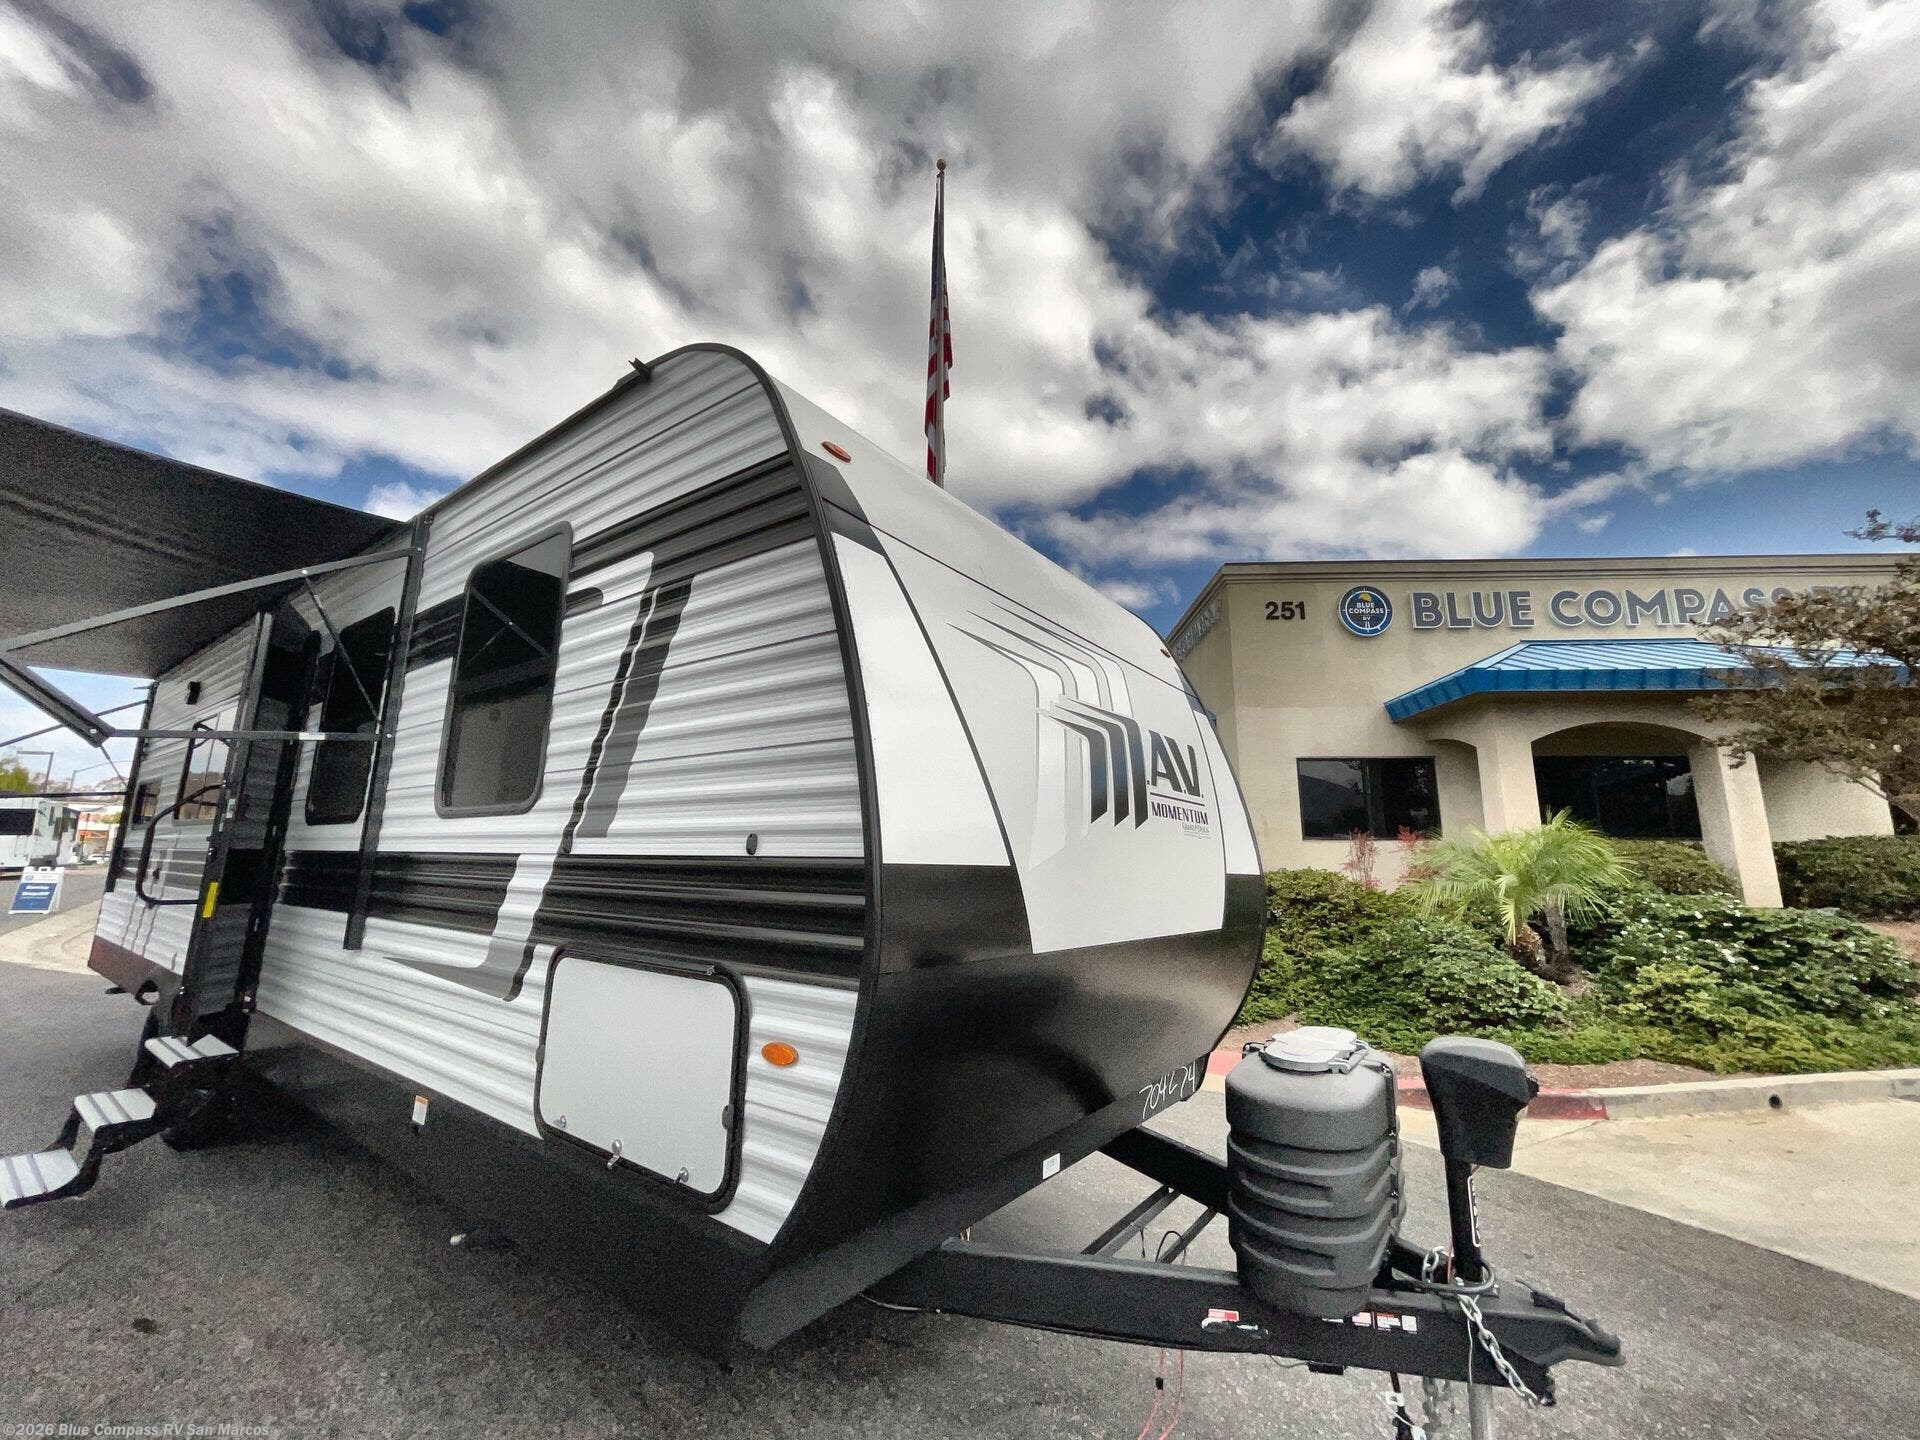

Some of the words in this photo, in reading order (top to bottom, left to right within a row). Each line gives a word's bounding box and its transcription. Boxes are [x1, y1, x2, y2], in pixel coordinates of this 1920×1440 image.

[1265, 601, 1306, 620] 251
[1411, 591, 1535, 628] BLUE
[1151, 801, 1209, 826] MOMENTUM
